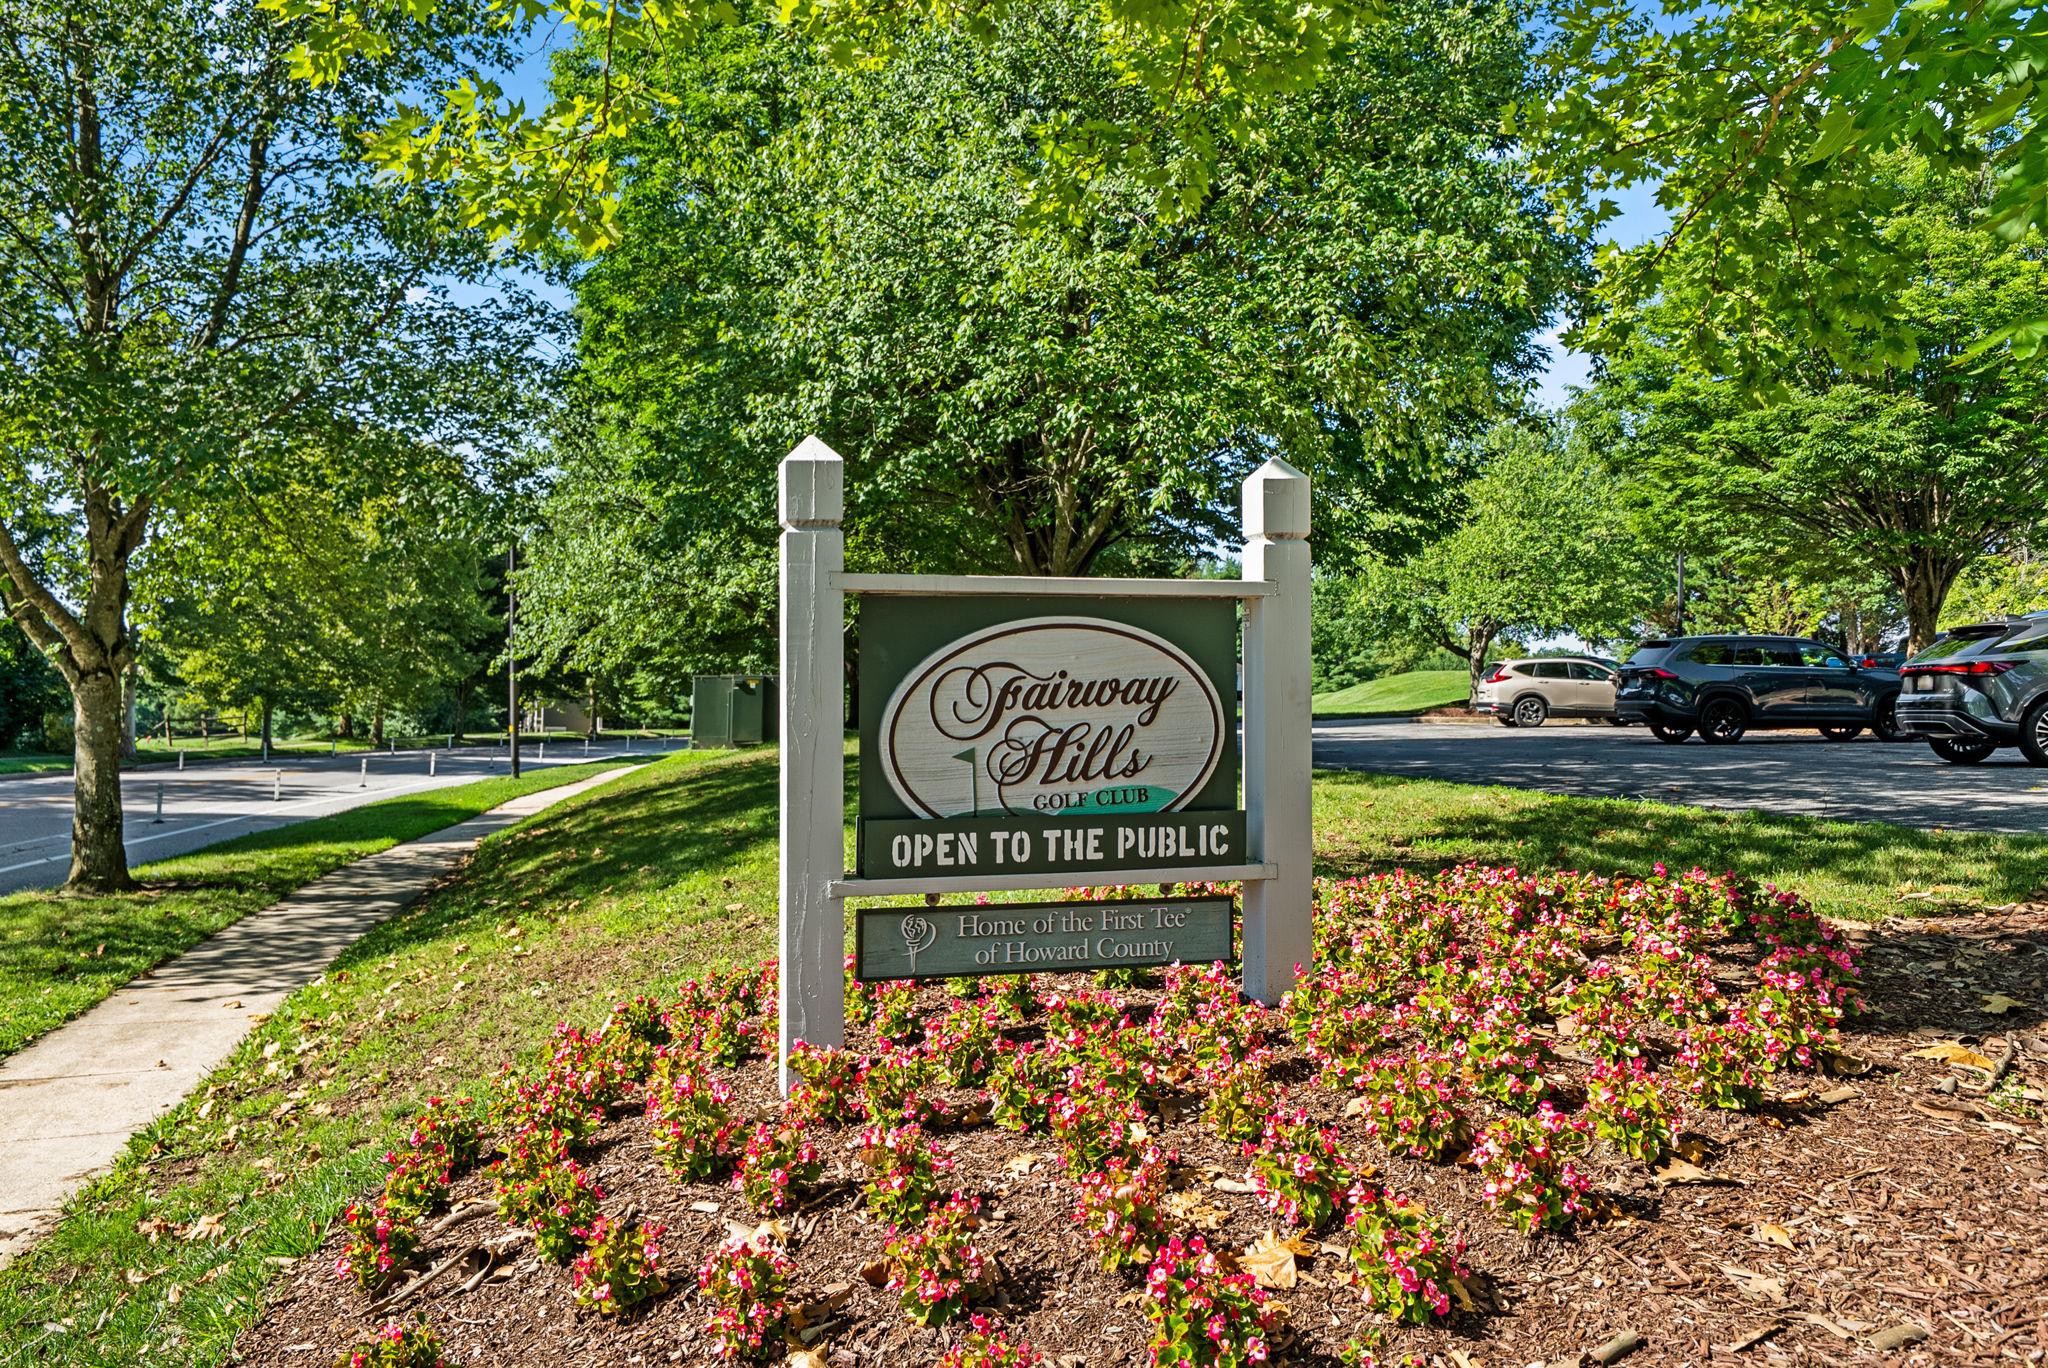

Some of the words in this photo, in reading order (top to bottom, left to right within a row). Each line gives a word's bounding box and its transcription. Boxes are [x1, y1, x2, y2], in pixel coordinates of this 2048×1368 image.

[930, 661, 1180, 741] Fairway
[986, 714, 1153, 787] Hills
[1033, 793, 1089, 811] GOLF
[1095, 787, 1149, 805] CLUB
[892, 832, 977, 867] OPEN
[990, 831, 1031, 864] TO
[1043, 828, 1104, 862] THE
[1117, 824, 1229, 859] PUBLIC
[957, 915, 1026, 937] Home
[1033, 911, 1058, 934] of
[1062, 911, 1093, 932] the
[1100, 909, 1145, 931] First
[975, 942, 1001, 965] of
[1006, 938, 1089, 963] Howard
[1096, 937, 1174, 962] County
